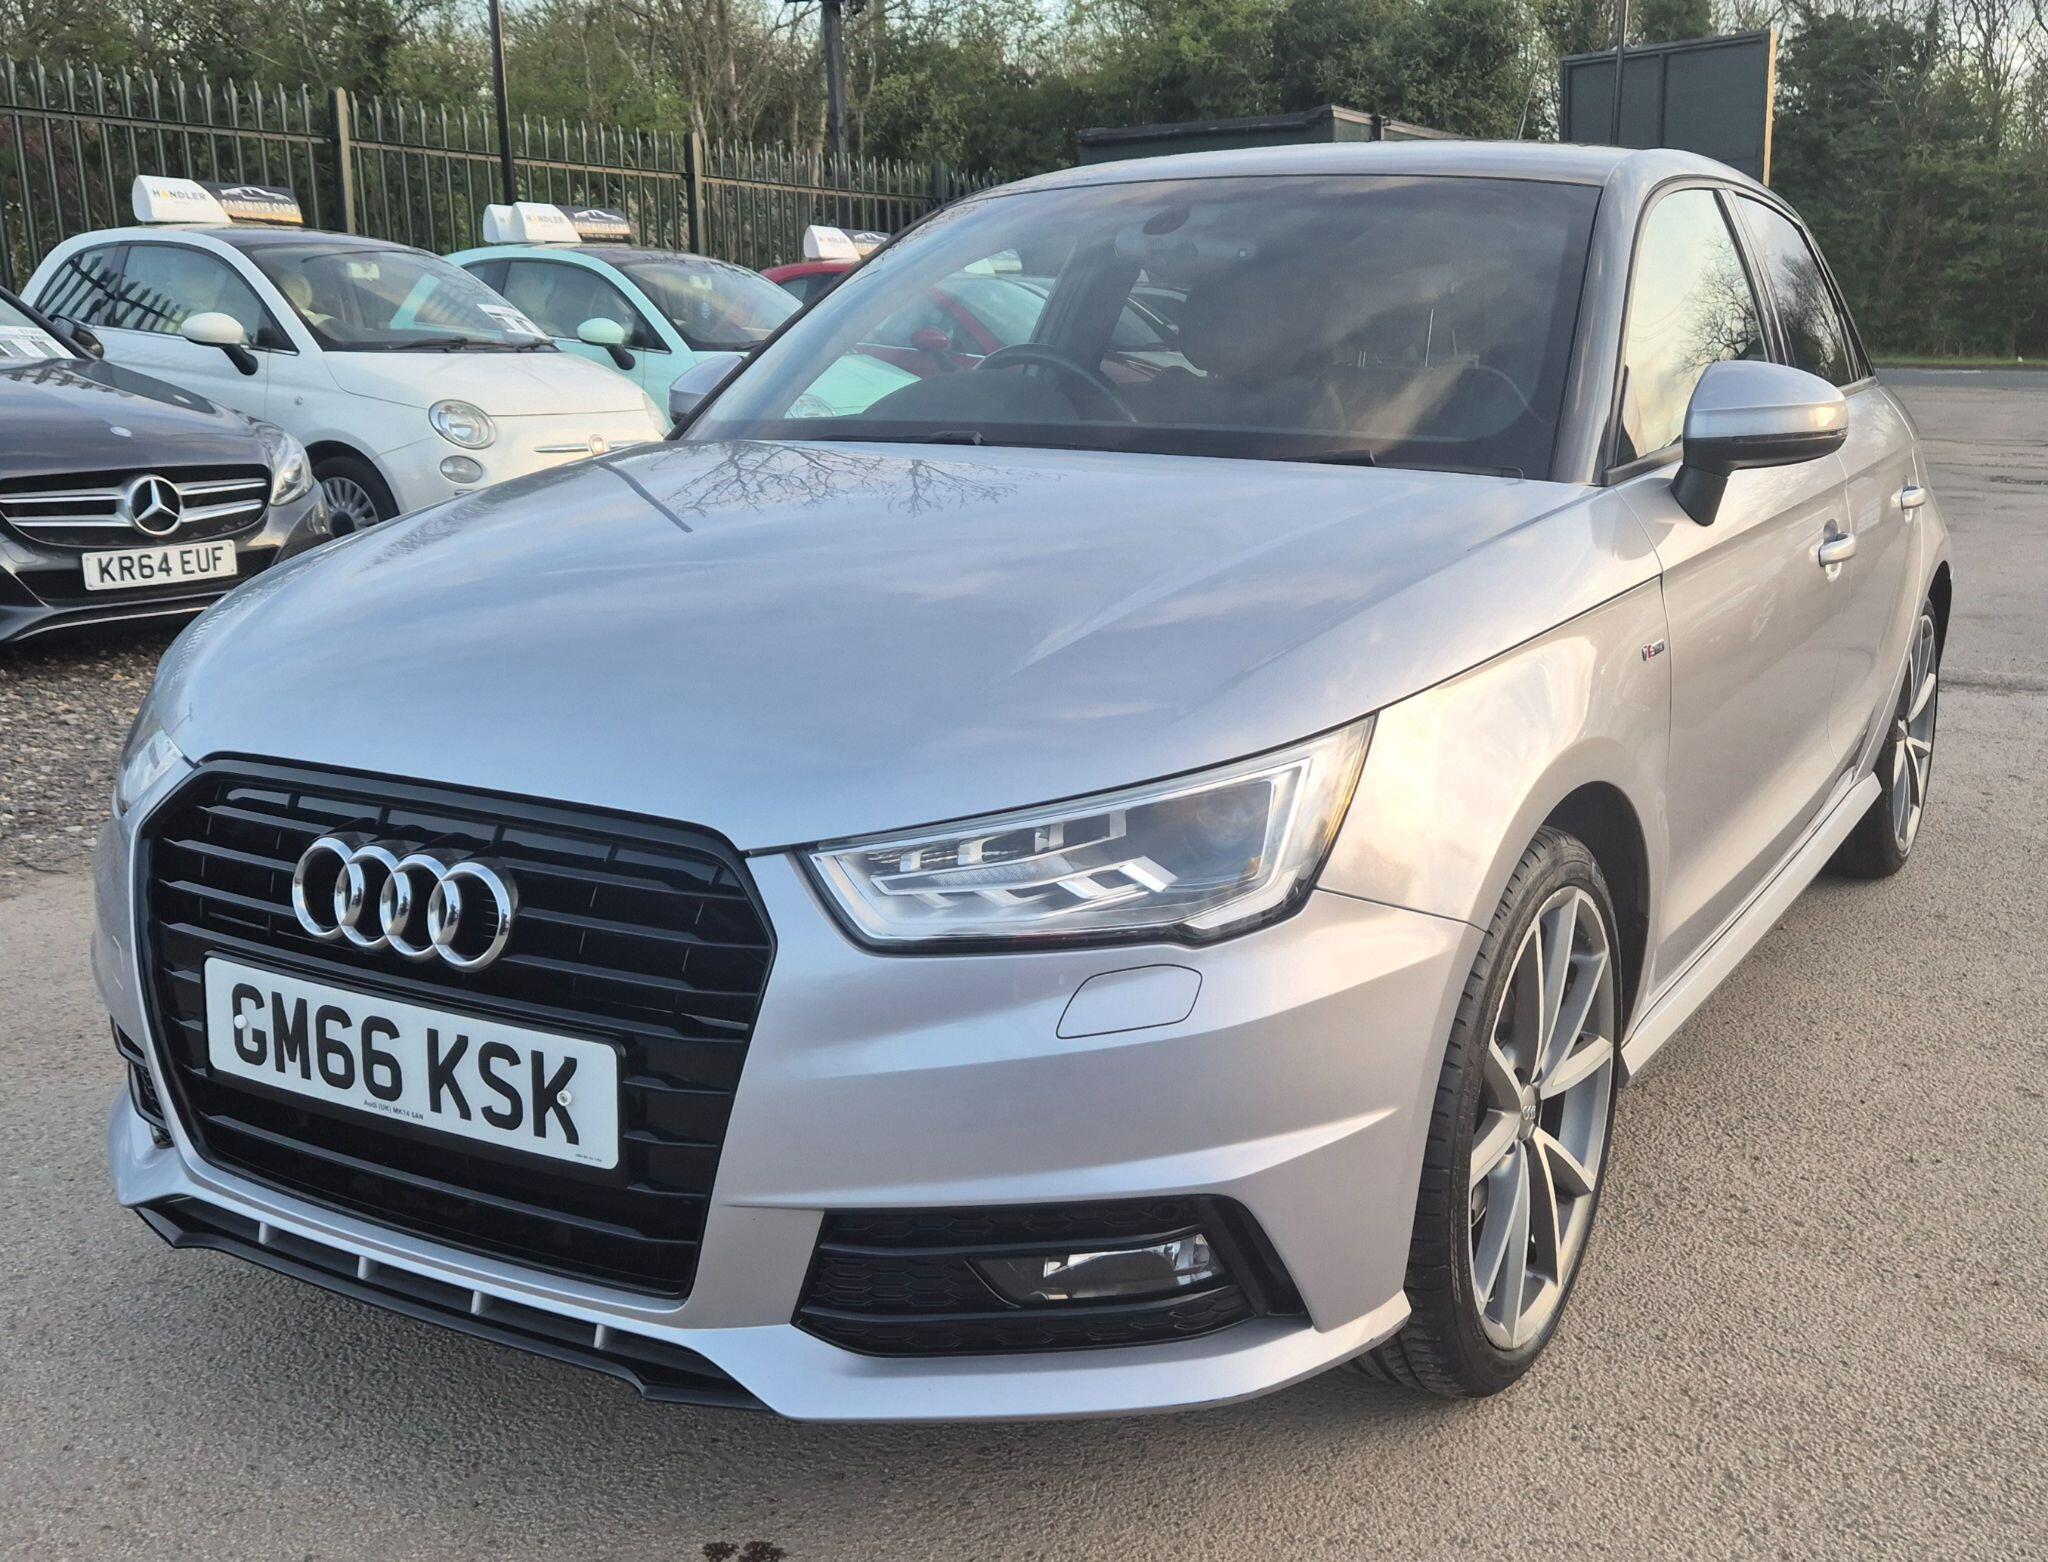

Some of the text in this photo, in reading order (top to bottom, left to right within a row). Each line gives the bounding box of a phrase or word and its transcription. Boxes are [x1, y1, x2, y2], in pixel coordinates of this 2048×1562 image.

[98, 546, 224, 583] KR64 EUF
[232, 982, 580, 1146] GM66 KSK
